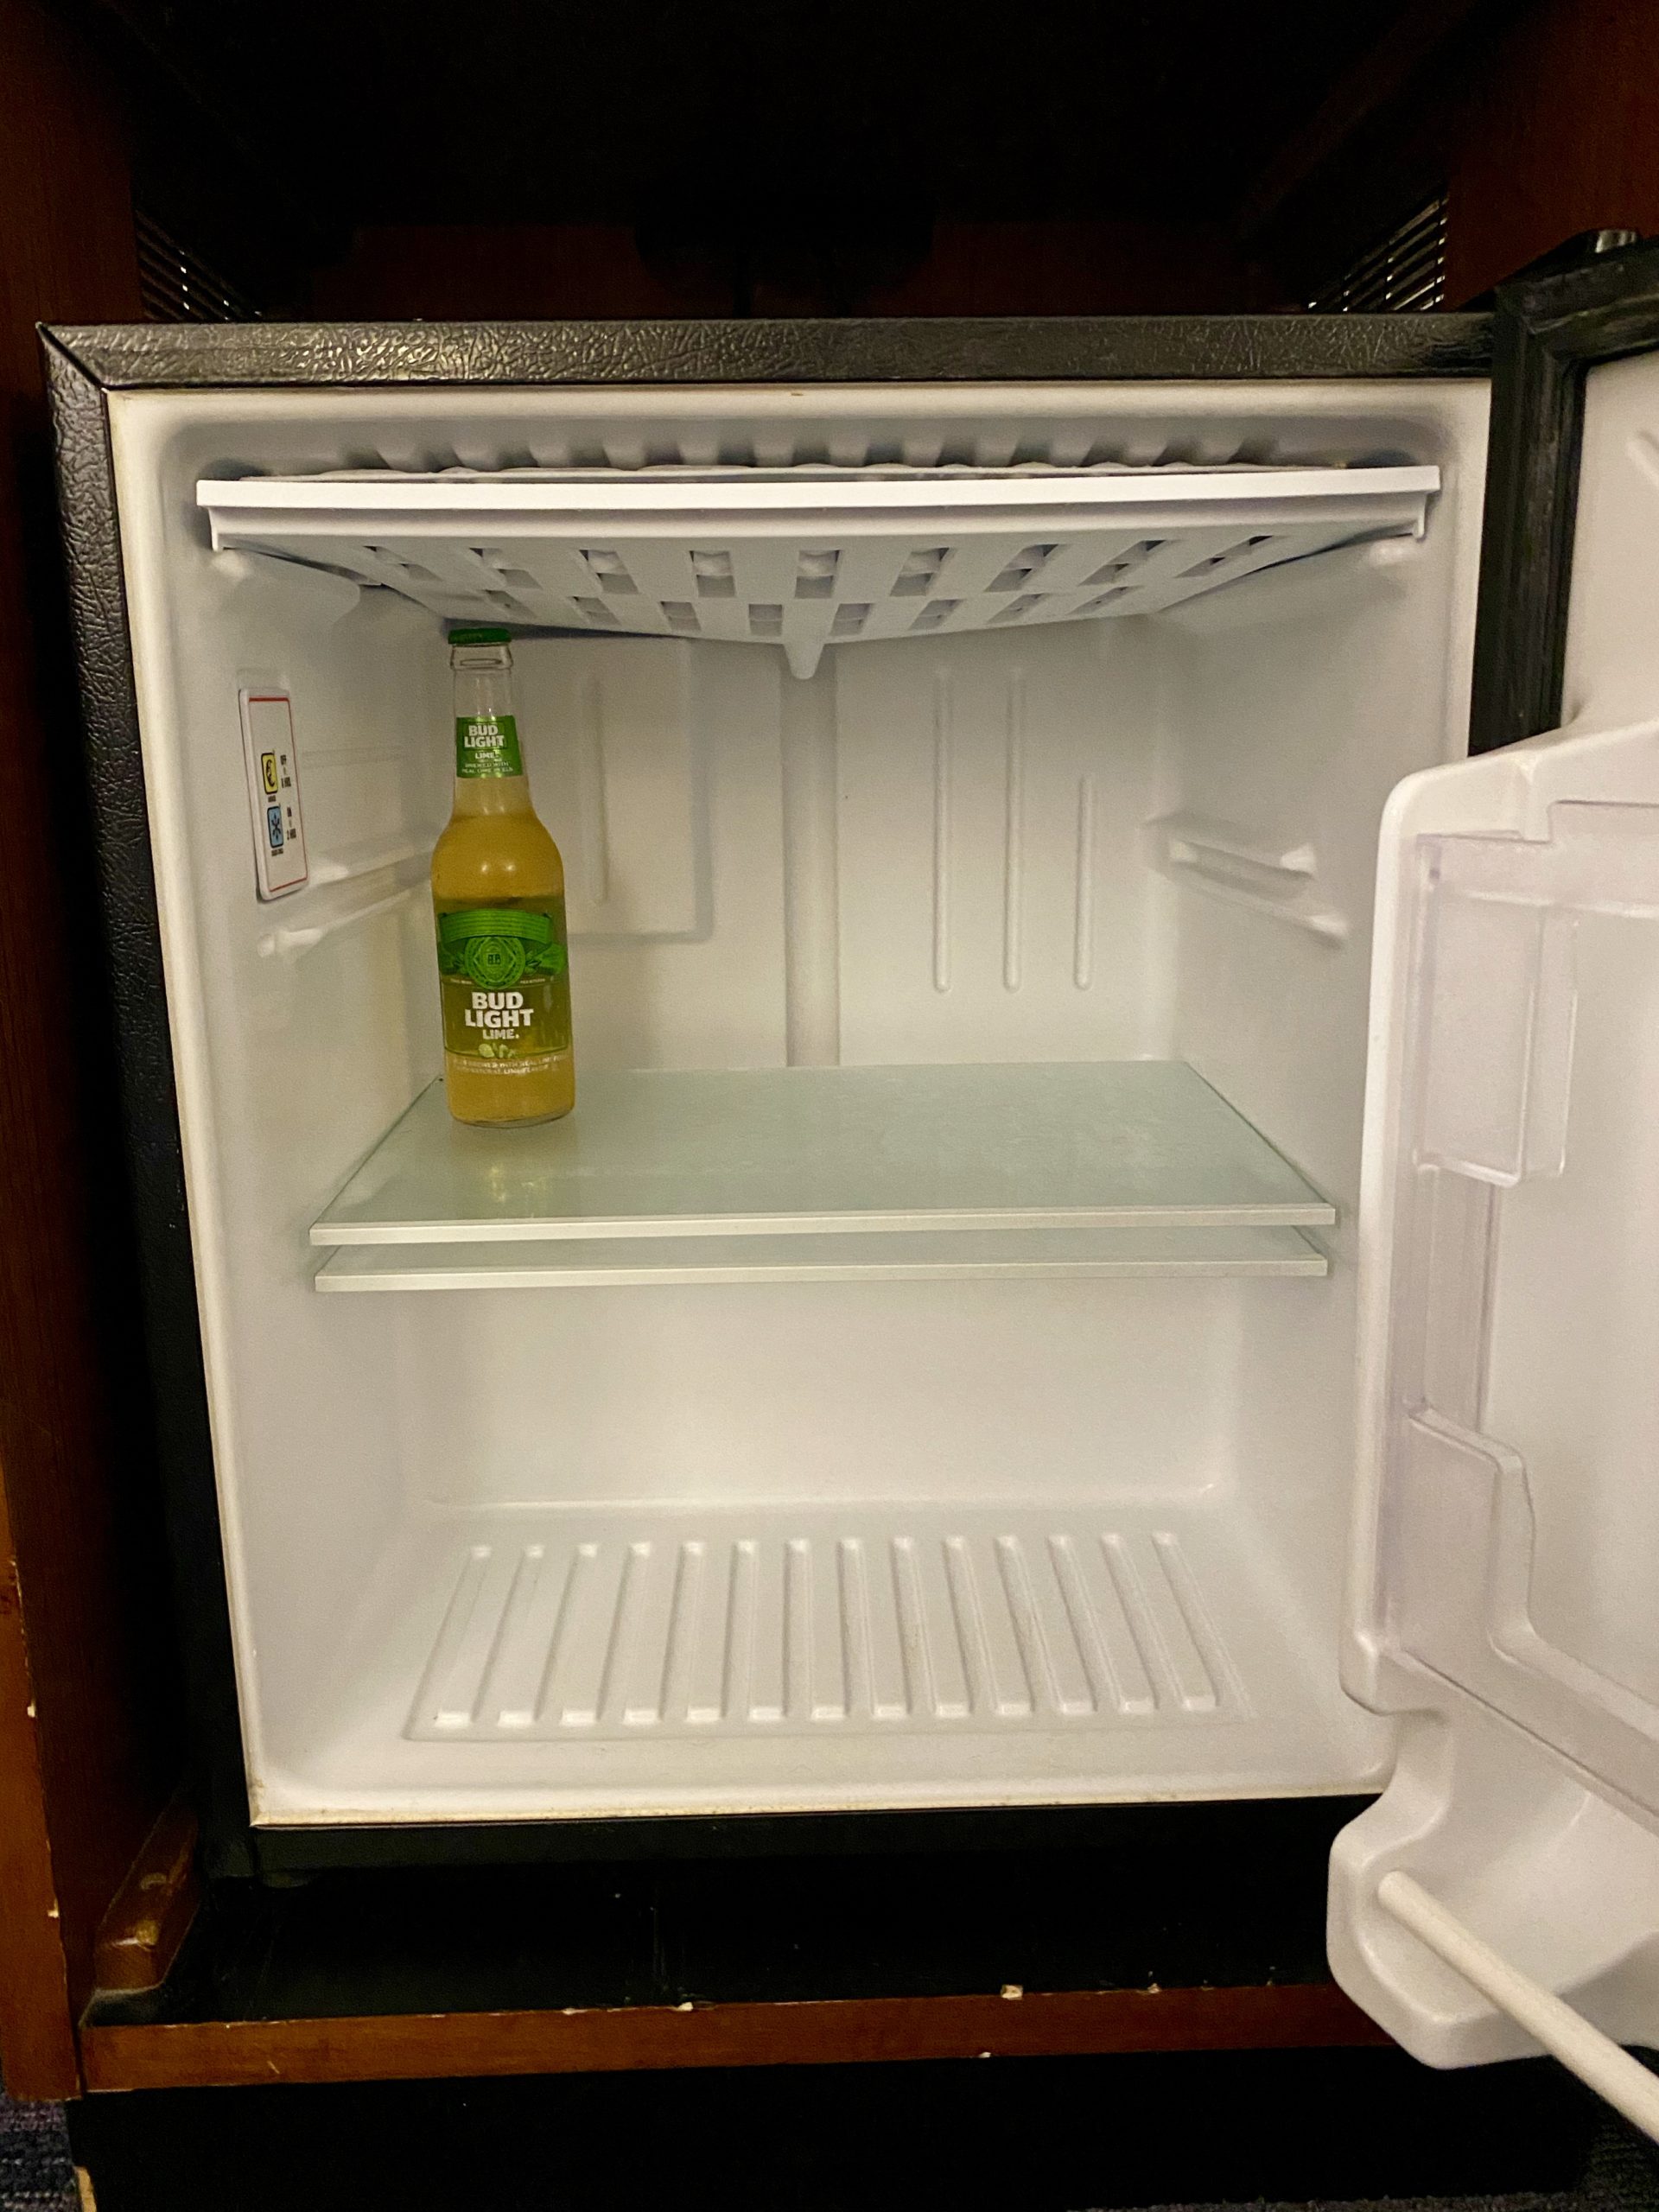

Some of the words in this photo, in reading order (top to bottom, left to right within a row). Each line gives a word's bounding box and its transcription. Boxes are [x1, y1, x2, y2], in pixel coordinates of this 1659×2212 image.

[468, 725, 499, 735] BUD
[464, 735, 505, 747] LIGHT
[472, 991, 524, 1010] BUD
[464, 1008, 534, 1028] LIGHT
